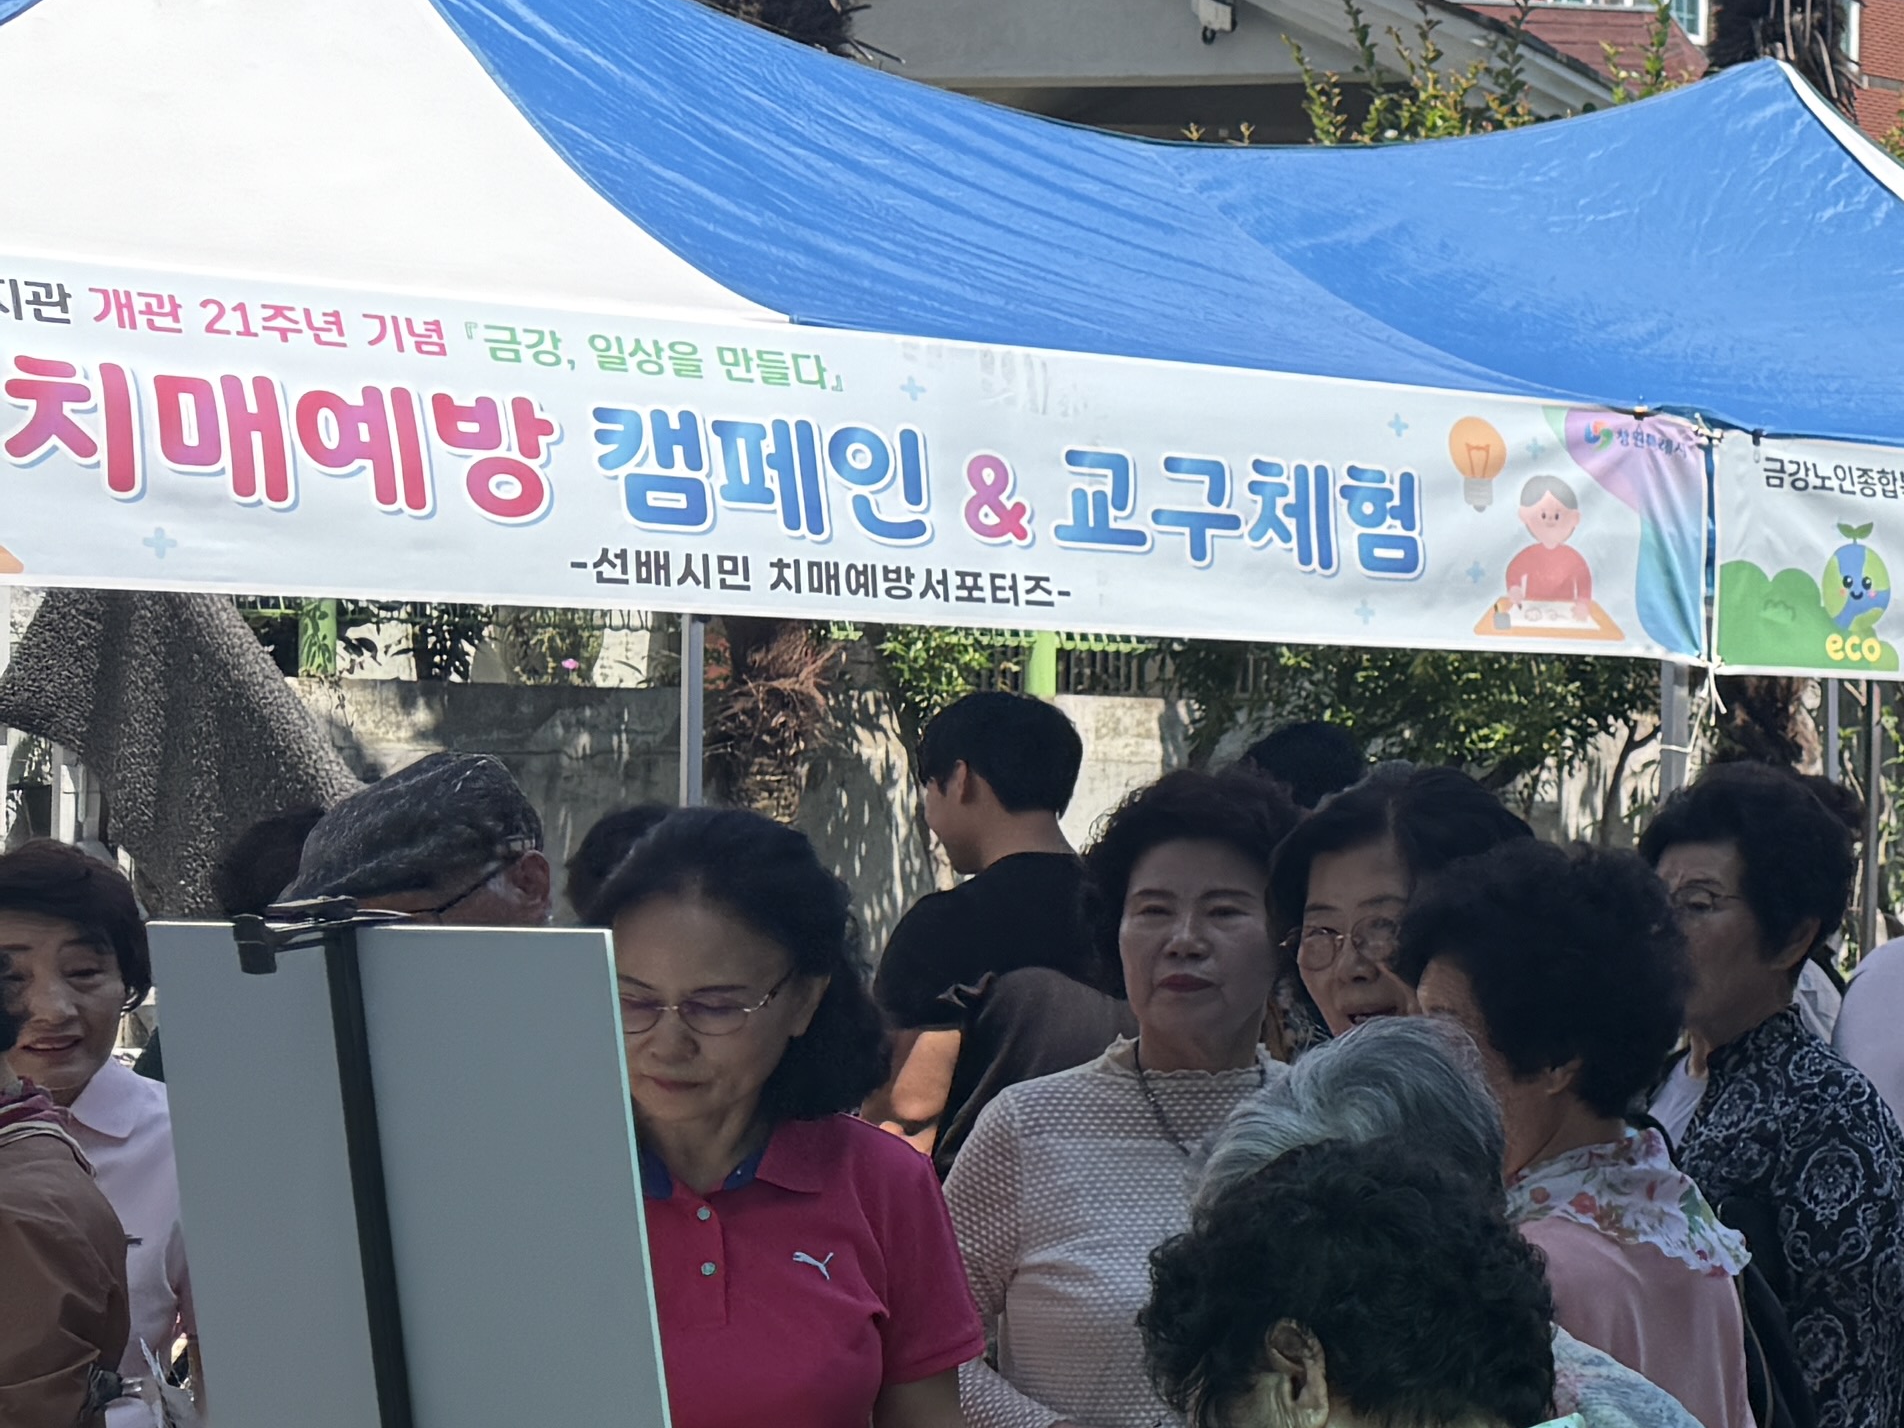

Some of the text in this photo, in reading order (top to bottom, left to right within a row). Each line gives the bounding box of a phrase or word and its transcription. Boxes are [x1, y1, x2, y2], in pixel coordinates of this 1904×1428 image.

[88, 286, 182, 335] 개관
[199, 298, 349, 349] 21주년
[366, 312, 448, 358] 기념
[587, 333, 704, 382] 일상을
[4, 355, 1424, 576] 치매예방 캠페인 & 교구체험
[1825, 634, 1881, 662] eco
